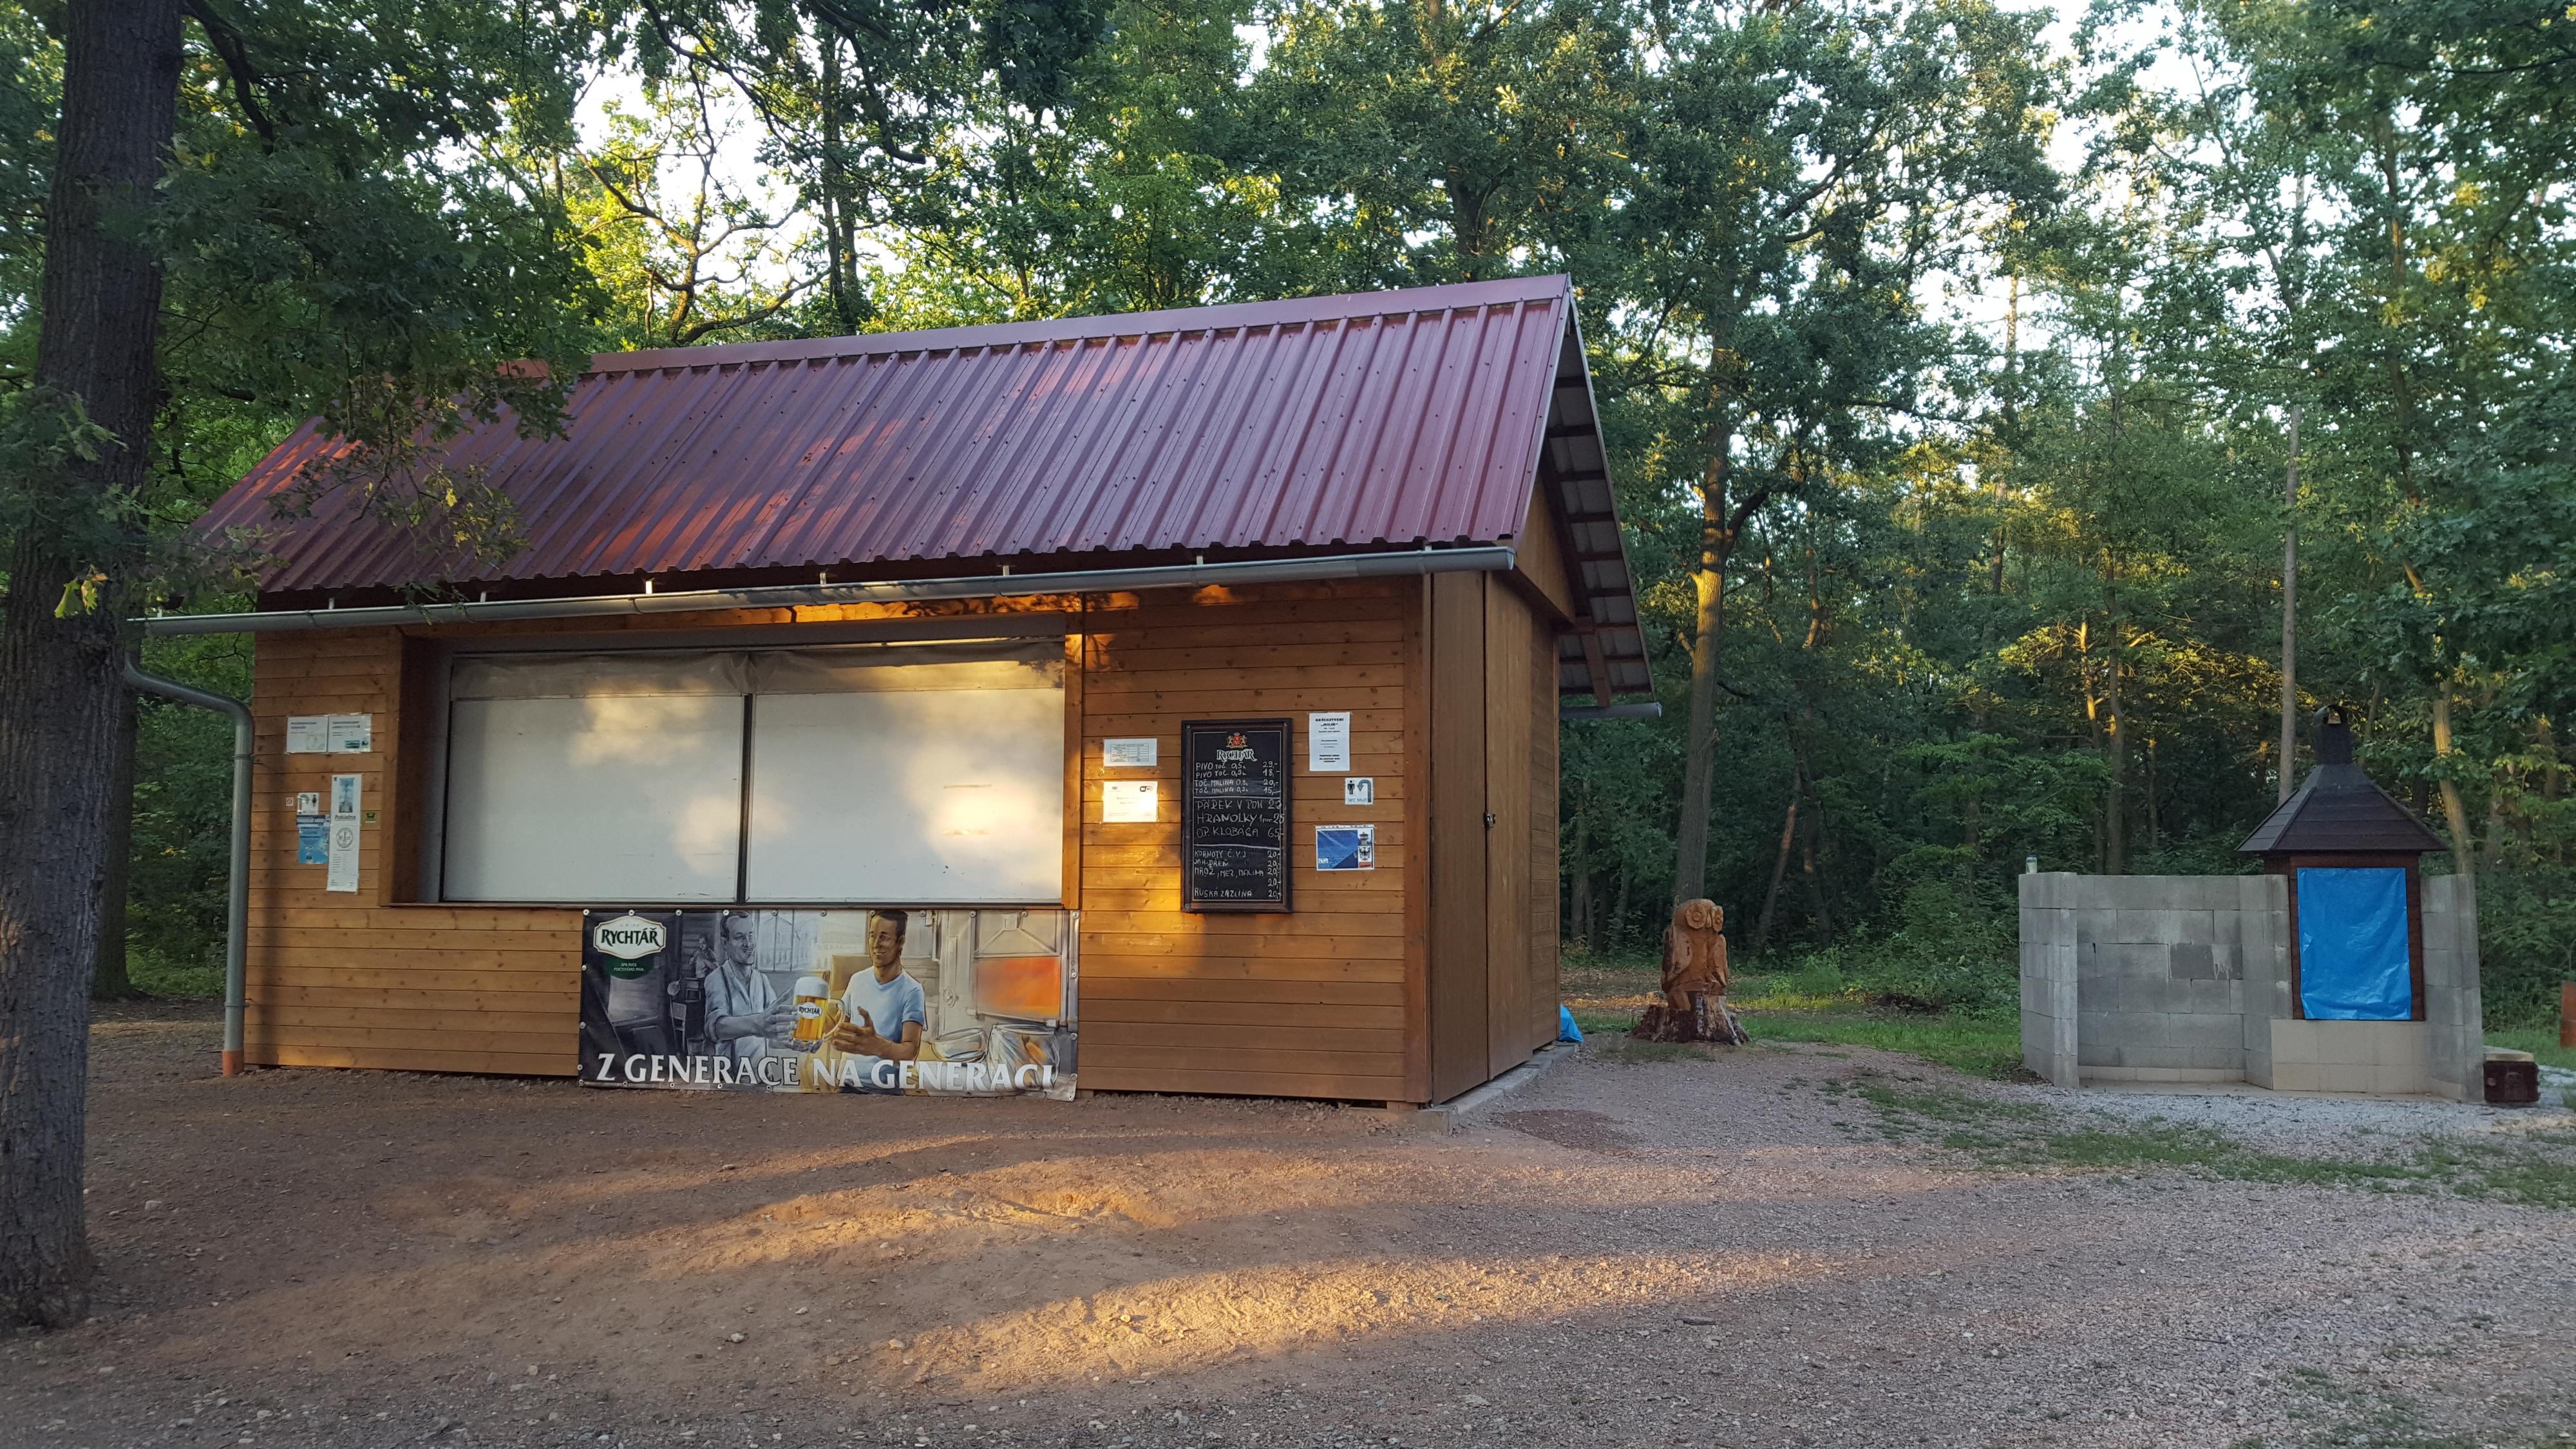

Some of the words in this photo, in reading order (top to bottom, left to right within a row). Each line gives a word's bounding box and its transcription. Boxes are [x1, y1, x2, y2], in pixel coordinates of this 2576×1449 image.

[1196, 762, 1213, 771] PIVO
[1196, 771, 1212, 779] PIVO
[1236, 800, 1242, 810] V
[1197, 813, 1257, 827] HRANOLKY
[601, 927, 661, 947] RYCHTÁŘ
[596, 1053, 616, 1081] Z
[623, 1054, 800, 1086] GENERACE
[812, 1058, 863, 1088] NA
[871, 1059, 1056, 1092] GENERACI
